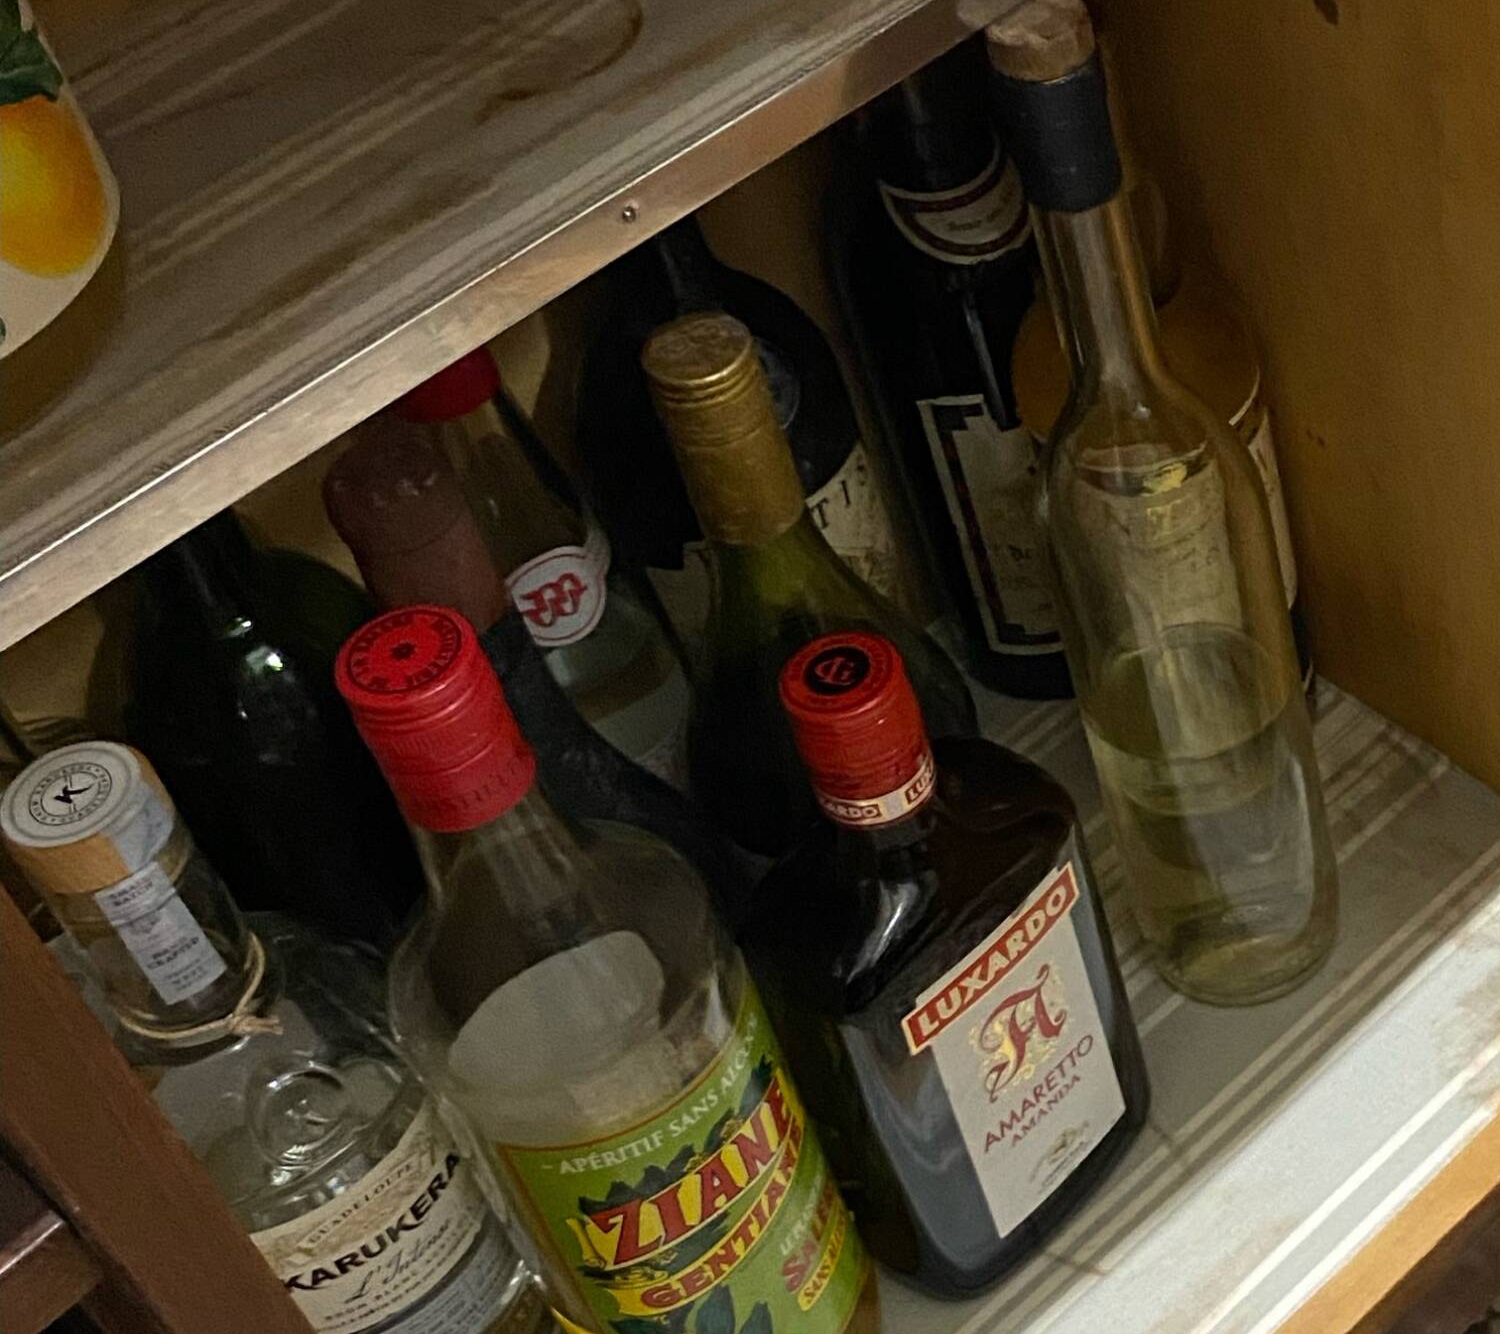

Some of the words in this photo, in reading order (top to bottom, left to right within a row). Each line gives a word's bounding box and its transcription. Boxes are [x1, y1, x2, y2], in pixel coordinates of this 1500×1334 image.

[916, 883, 1069, 1040] LUXARDO
[559, 1129, 666, 1175] APÉRITIF
[669, 1093, 720, 1139] SANS
[983, 1033, 1096, 1154] AMARETTO
[1010, 1071, 1082, 1148] AMANDA
[281, 1151, 462, 1294] KARUKERA
